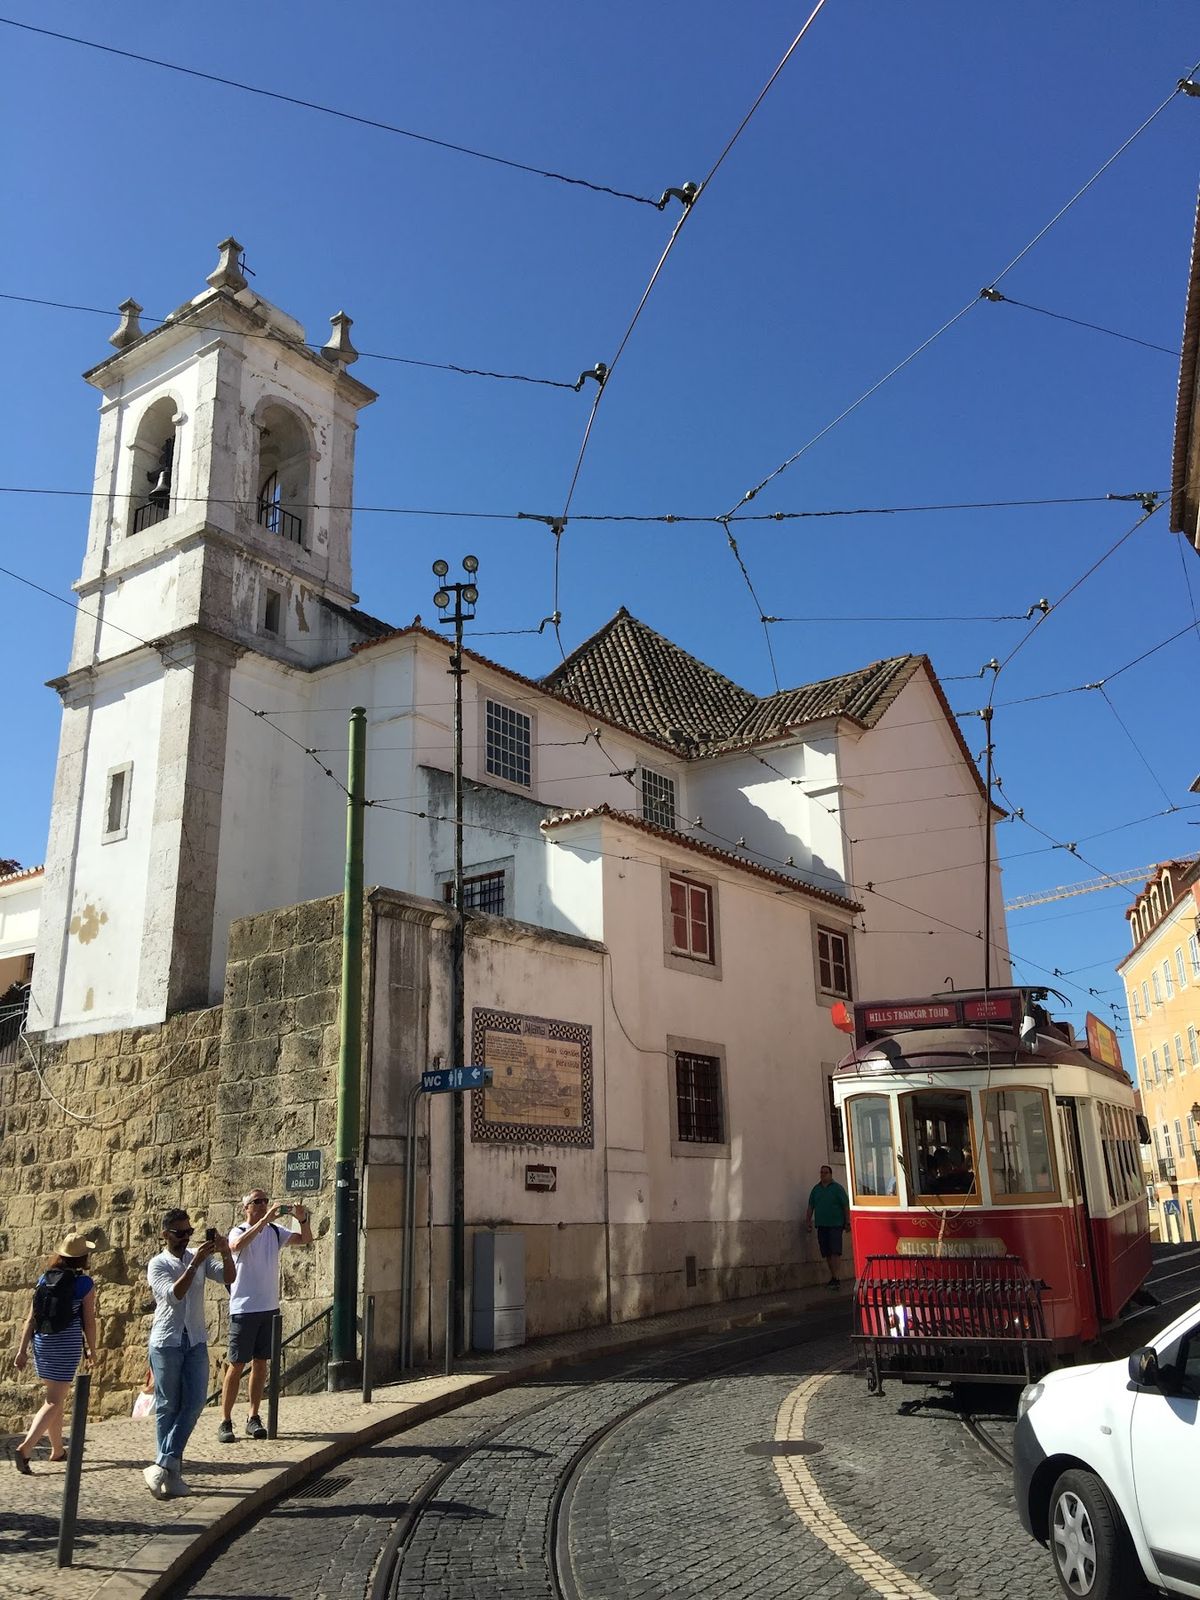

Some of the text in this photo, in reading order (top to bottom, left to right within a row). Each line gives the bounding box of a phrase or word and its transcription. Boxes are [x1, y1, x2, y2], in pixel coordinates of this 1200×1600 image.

[928, 1007, 949, 1018] TOUR
[423, 1075, 442, 1088] WC
[927, 1071, 934, 1085] 5
[297, 1152, 309, 1160] RUA
[288, 1161, 319, 1171] NORBERTO
